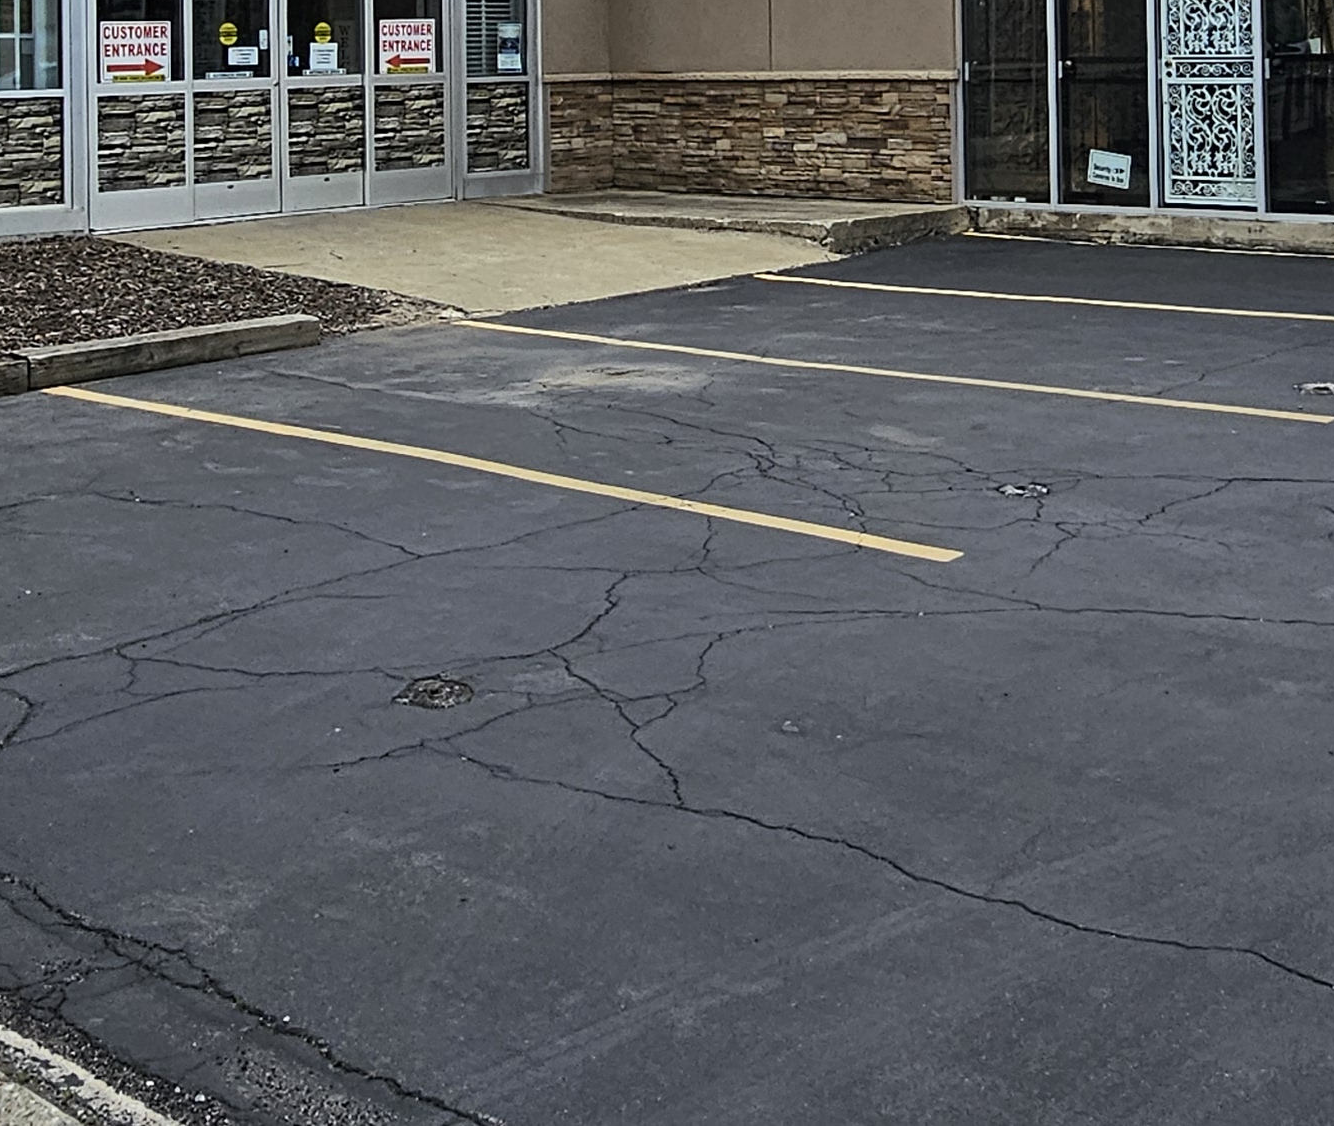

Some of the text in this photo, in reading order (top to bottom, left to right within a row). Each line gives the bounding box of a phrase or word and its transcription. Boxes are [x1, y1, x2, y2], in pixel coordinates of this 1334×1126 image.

[103, 26, 168, 39] CUSTOMER
[381, 24, 432, 36] CUSTOMER
[104, 43, 167, 57] ENTRANCE
[382, 39, 432, 52] ENTRANCE
